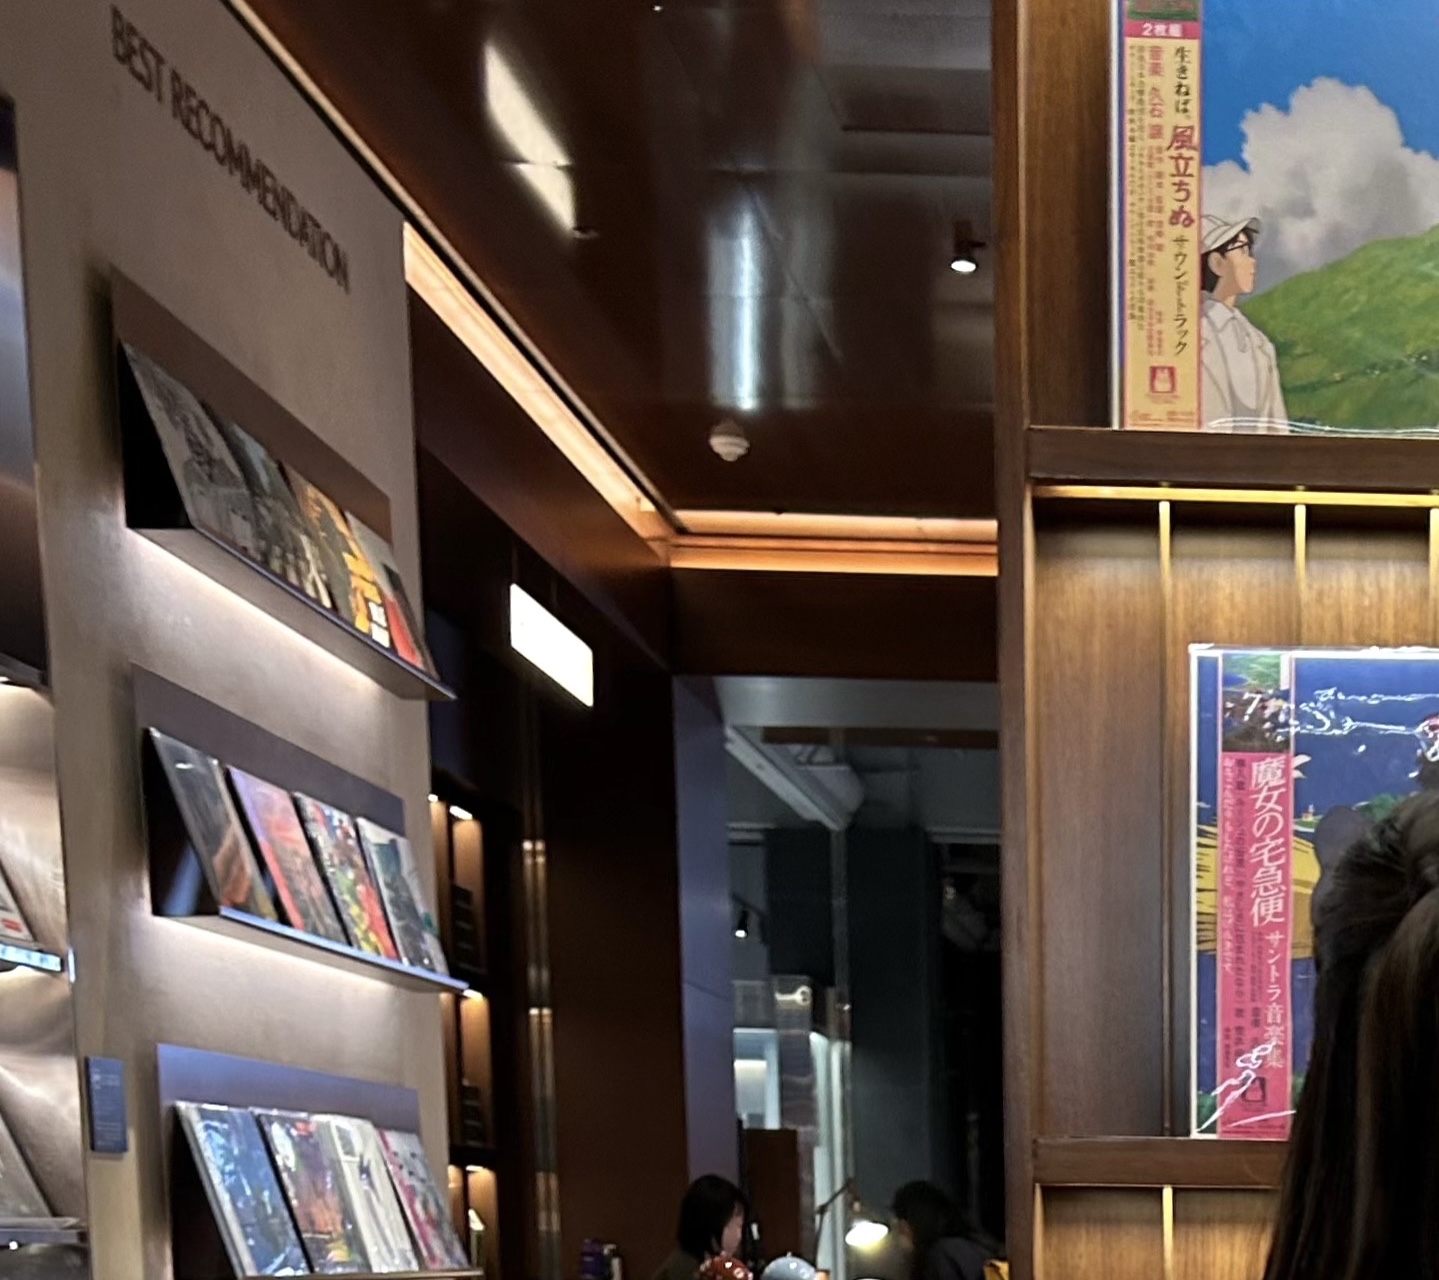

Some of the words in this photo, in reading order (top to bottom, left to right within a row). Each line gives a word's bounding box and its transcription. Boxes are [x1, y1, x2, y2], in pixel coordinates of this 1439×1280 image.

[110, 3, 165, 103] BEST
[170, 68, 350, 295] RECOMMENDATION
[1167, 125, 1199, 228] 風立ちぬ
[1172, 235, 1191, 356] サウンドトラック
[1249, 756, 1287, 927] 魔女の宅急便
